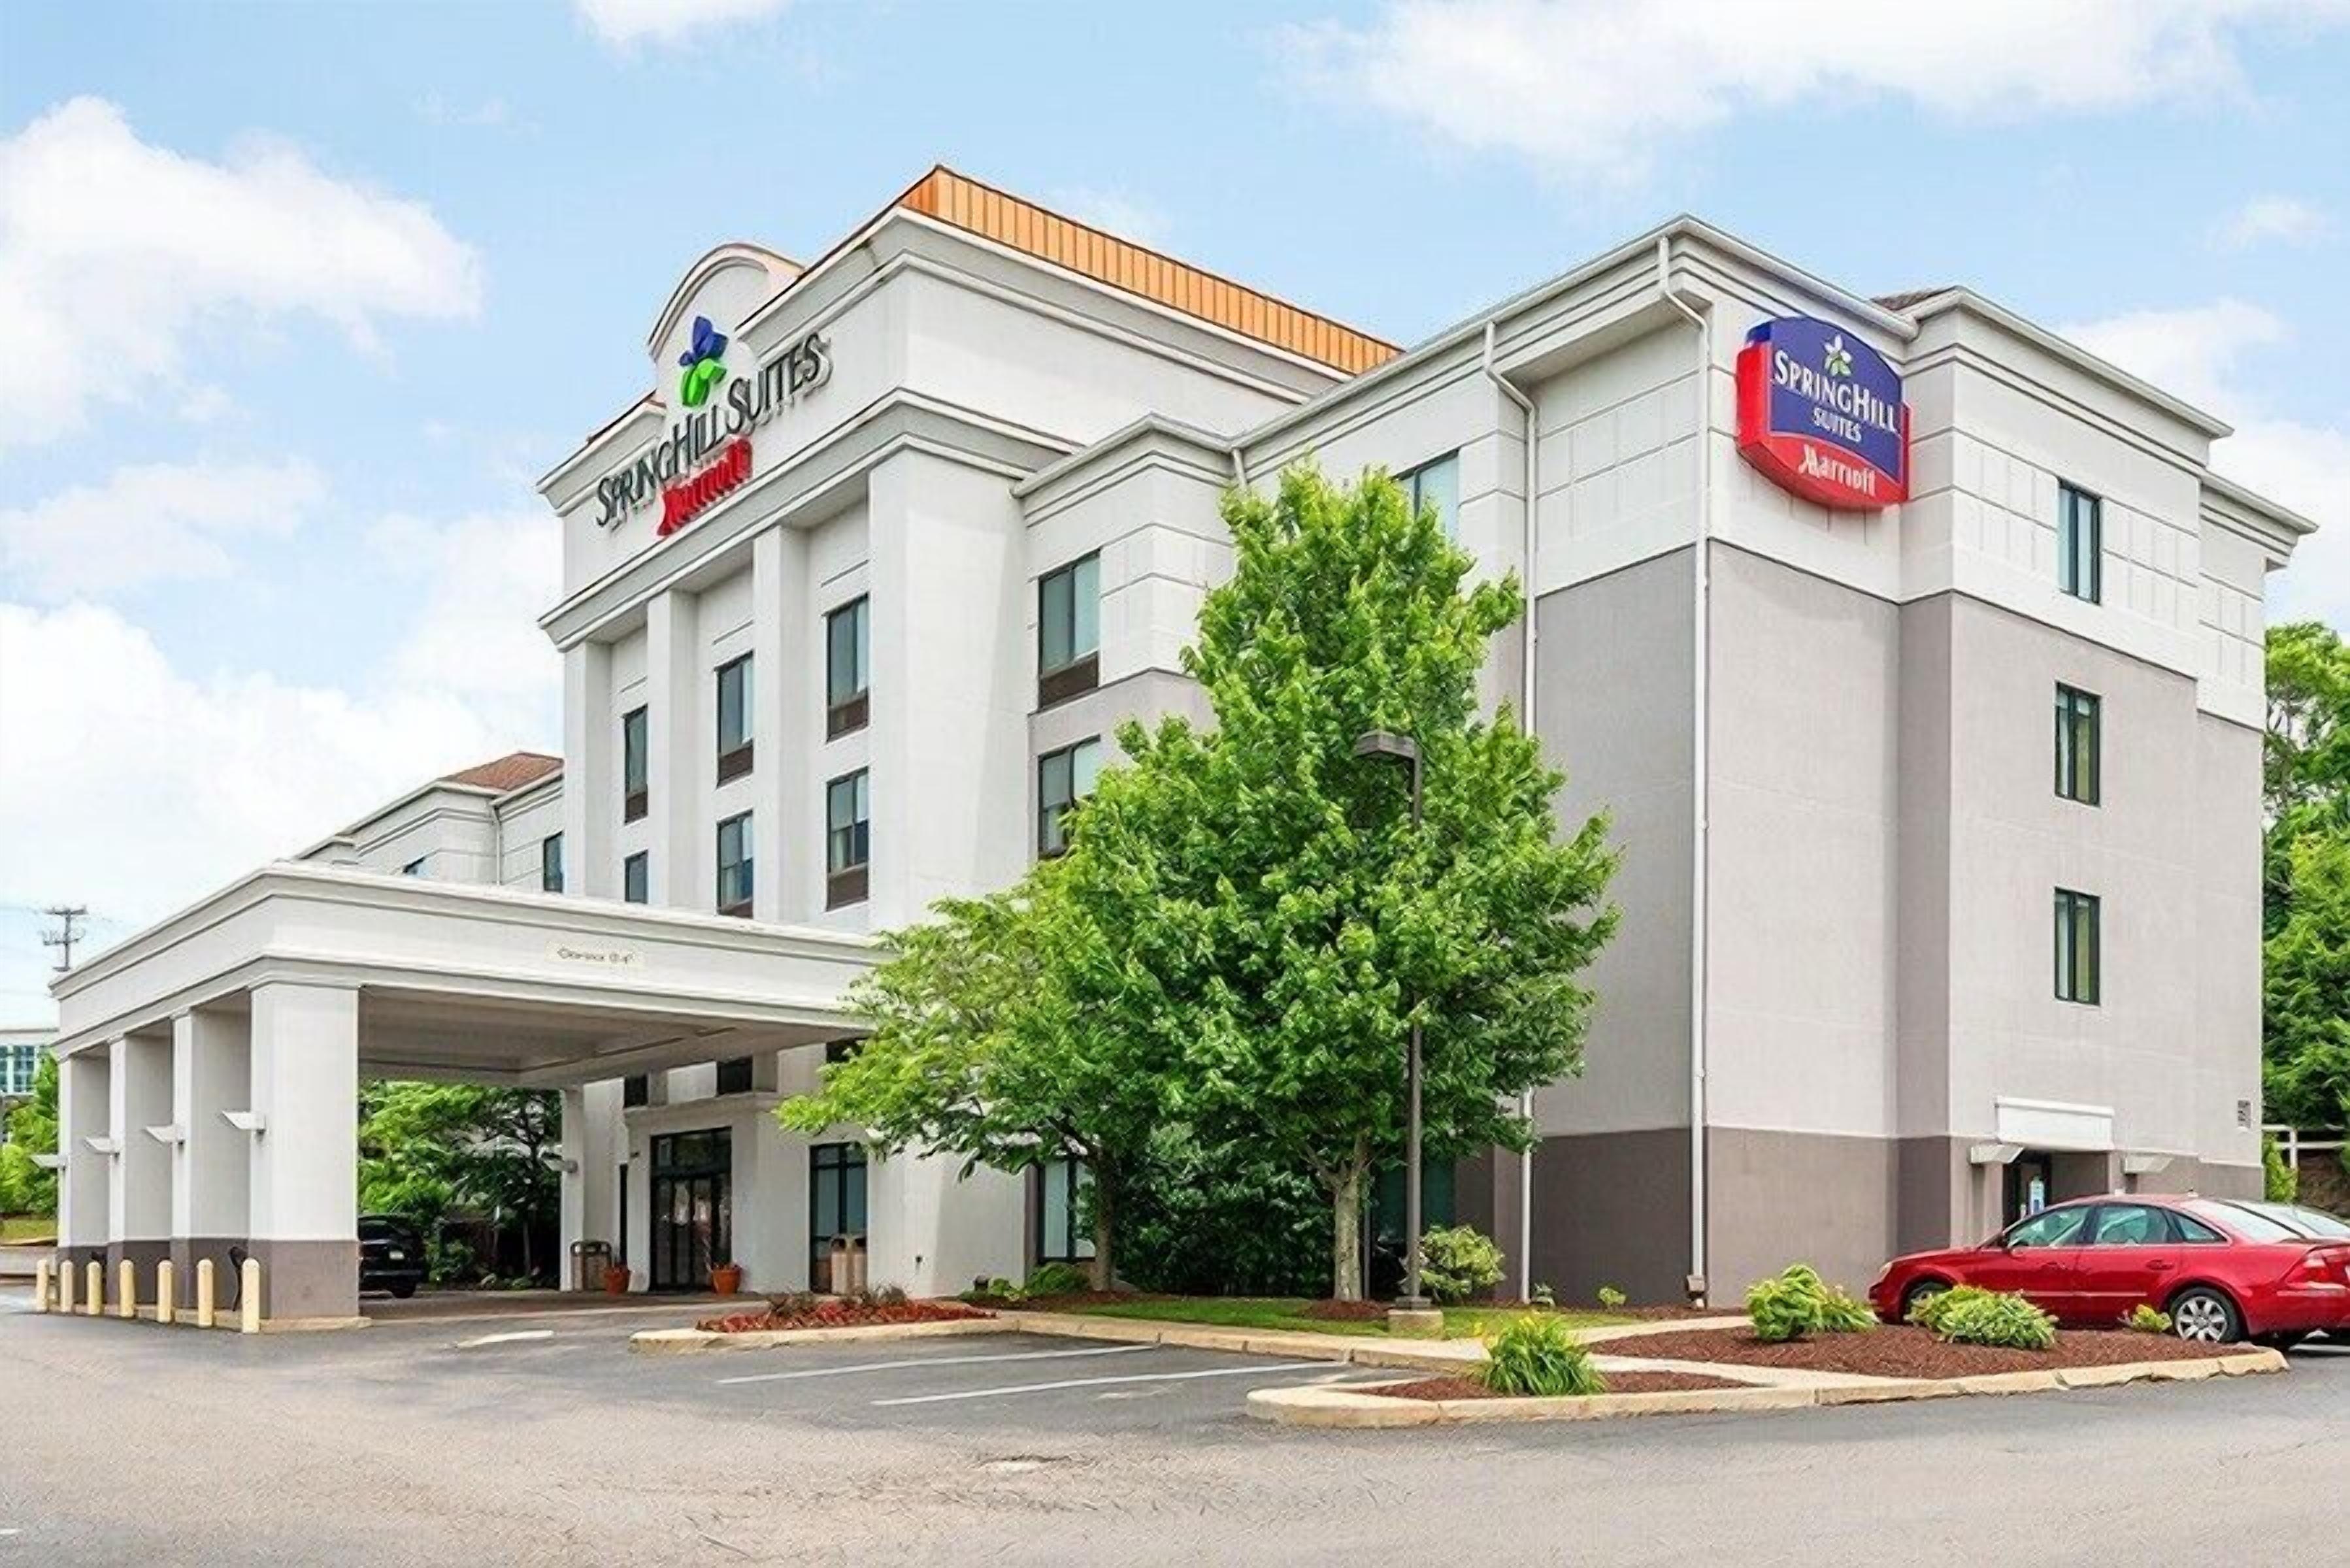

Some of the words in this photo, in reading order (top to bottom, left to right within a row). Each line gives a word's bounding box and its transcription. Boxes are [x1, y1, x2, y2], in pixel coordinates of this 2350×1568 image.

[725, 331, 833, 436] SUITES
[1813, 407, 1861, 442] SUITES
[1798, 444, 1876, 497] Marriott
